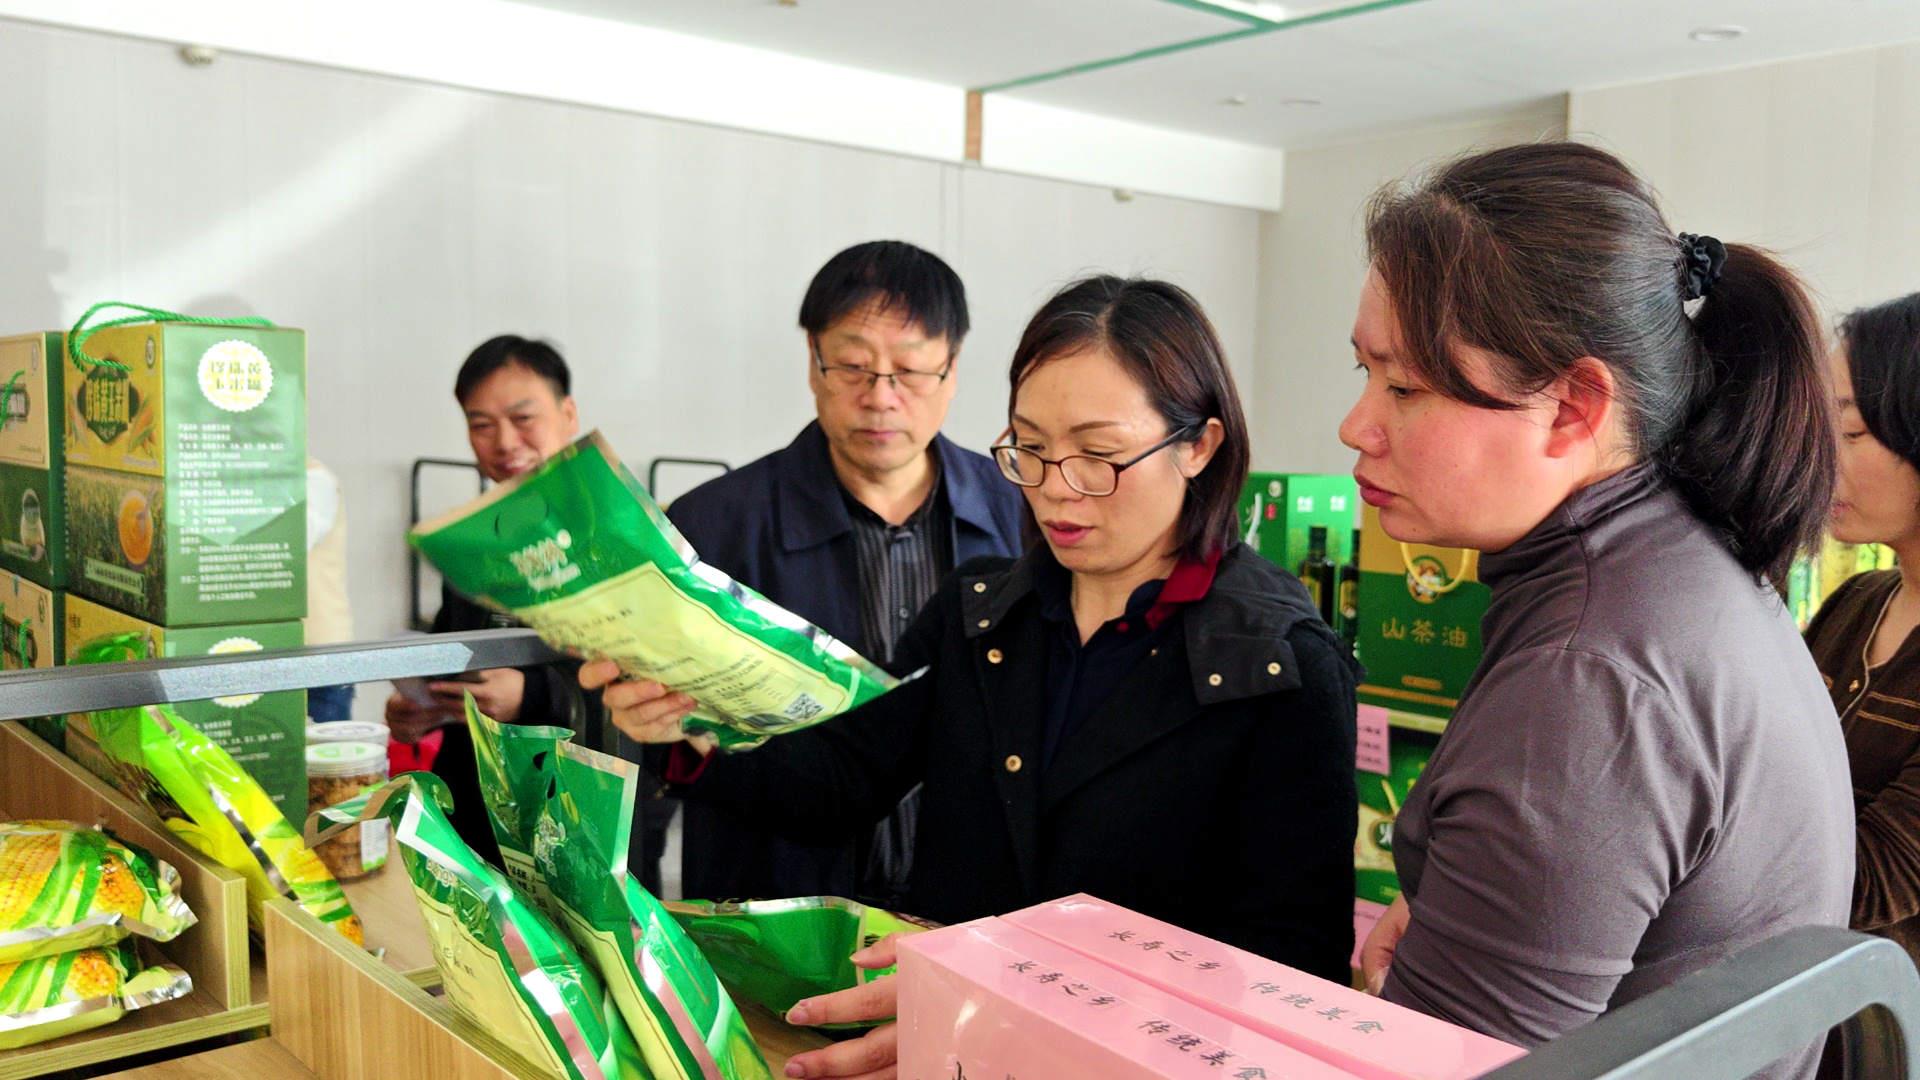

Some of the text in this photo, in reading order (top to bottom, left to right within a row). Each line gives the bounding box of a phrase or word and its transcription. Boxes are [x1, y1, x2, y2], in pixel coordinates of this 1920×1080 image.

[1382, 617, 1468, 648] 山茶油
[1008, 960, 1266, 1080] 长寿之乡 传统美食
[1108, 929, 1384, 1034] 长寿之乡 传统美食
